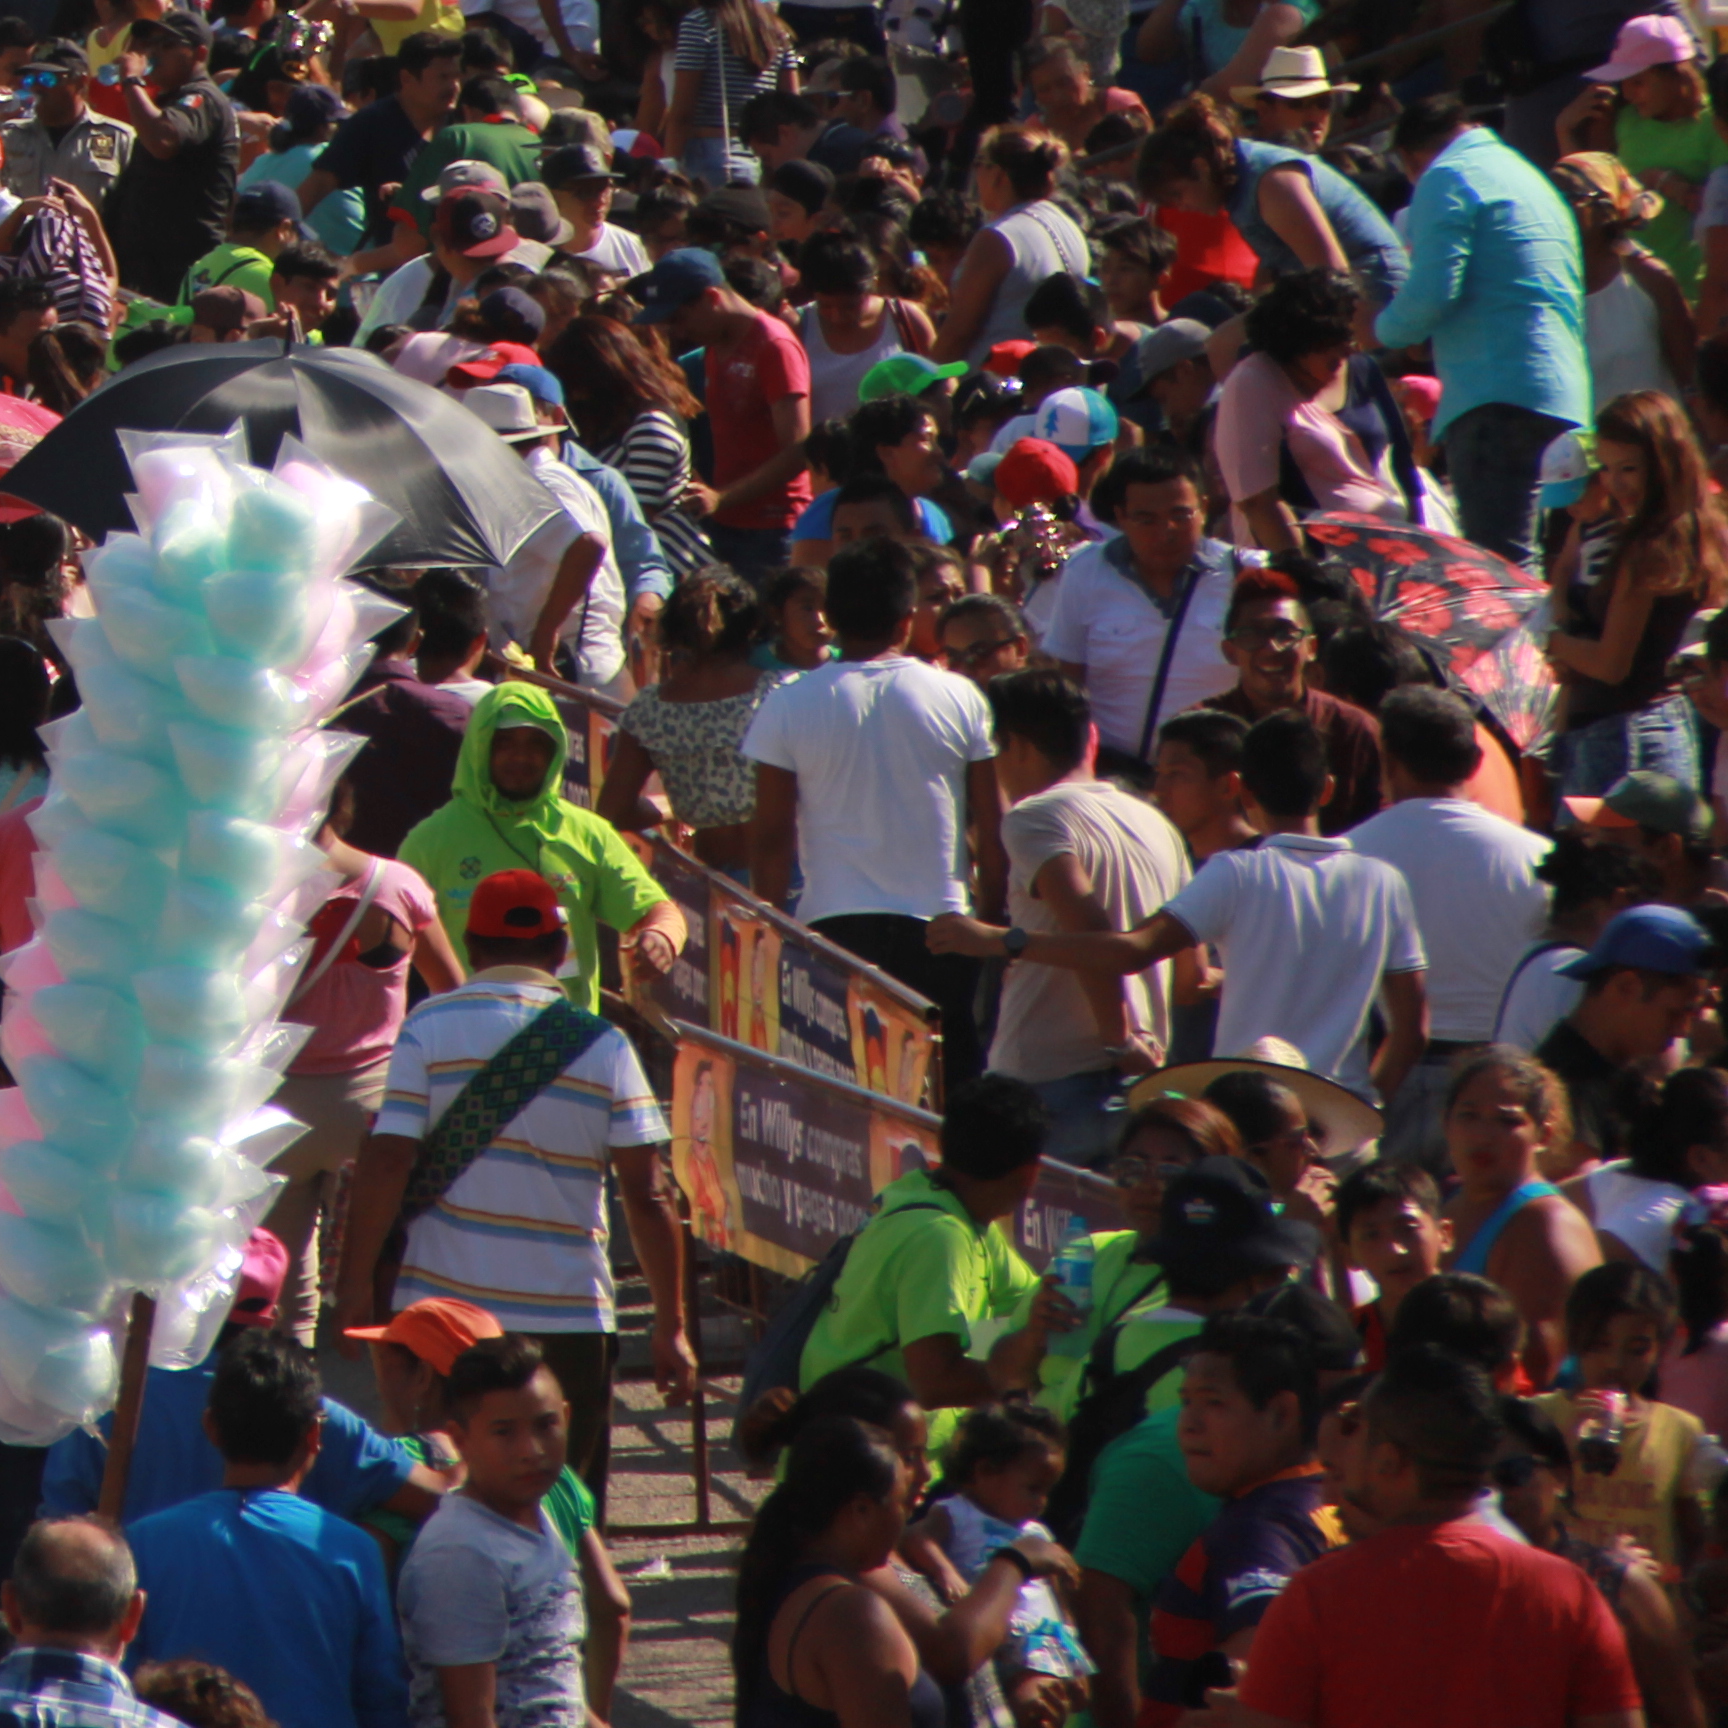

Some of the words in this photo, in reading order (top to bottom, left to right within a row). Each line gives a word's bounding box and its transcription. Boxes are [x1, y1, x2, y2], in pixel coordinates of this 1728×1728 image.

[740, 1091, 758, 1142] En
[761, 1097, 804, 1164] Willys
[807, 1125, 863, 1182] compras
[735, 1159, 781, 1210] mucho
[783, 1178, 792, 1225] y
[794, 1181, 836, 1236] pagas
[1023, 1198, 1042, 1250] En
